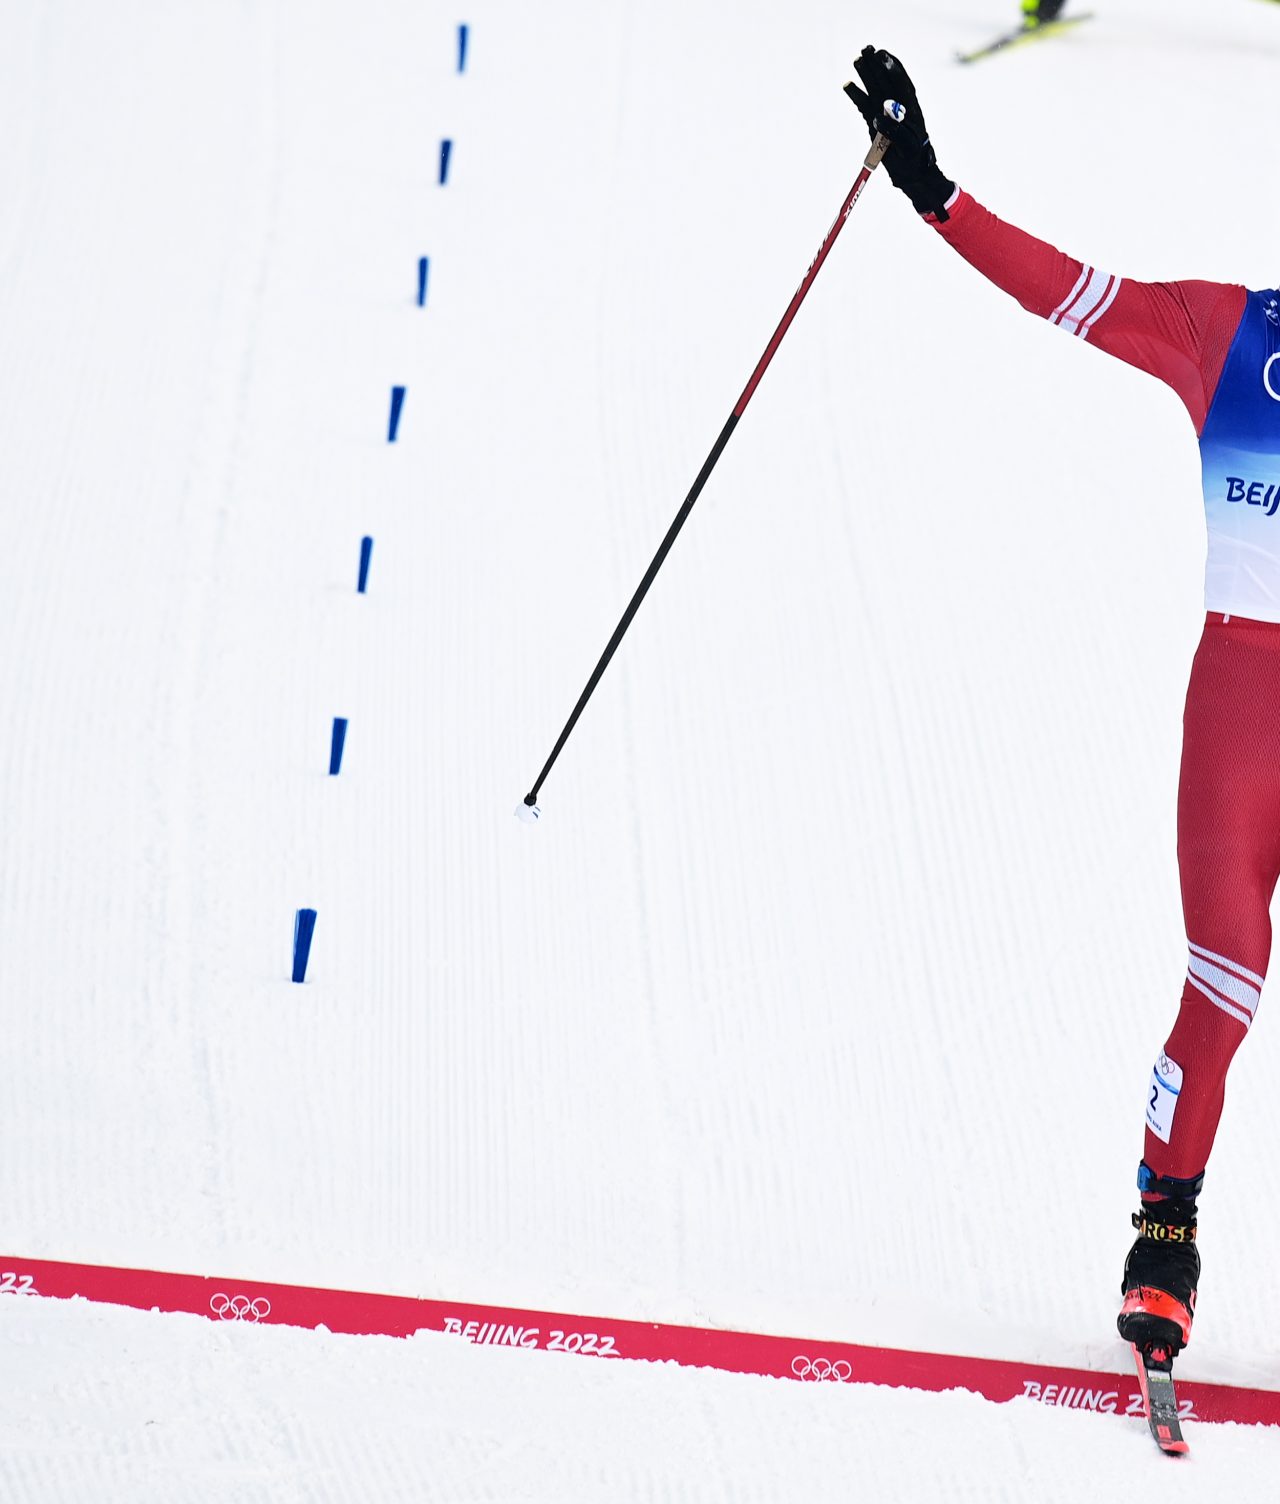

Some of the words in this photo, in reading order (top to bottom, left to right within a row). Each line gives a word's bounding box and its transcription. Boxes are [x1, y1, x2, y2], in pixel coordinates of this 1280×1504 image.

[1150, 1084, 1159, 1112] 2
[546, 1330, 621, 1357] 2022
[1125, 1393, 1199, 1420] 22
